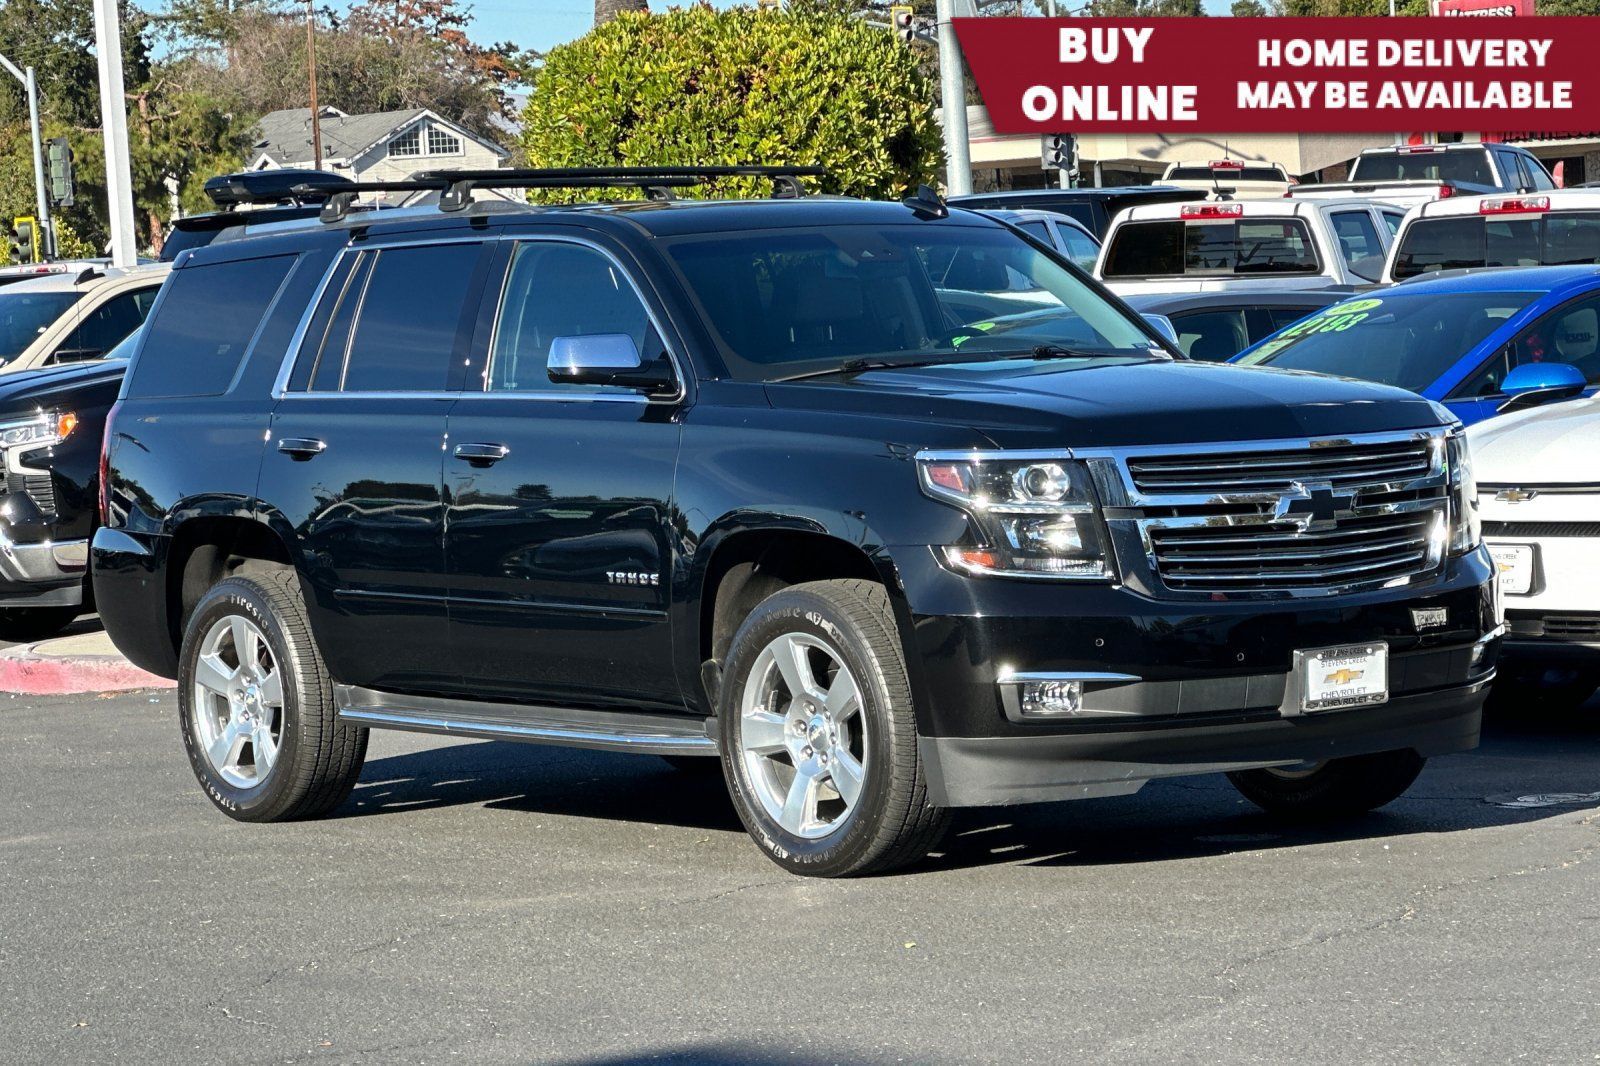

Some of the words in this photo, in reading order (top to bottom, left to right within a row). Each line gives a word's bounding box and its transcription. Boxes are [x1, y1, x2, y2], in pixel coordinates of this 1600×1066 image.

[605, 571, 660, 586] TAHOE
[1321, 649, 1348, 658] STEVENS
[1349, 647, 1367, 655] CREEK
[1321, 659, 1348, 668] STEVENS
[1349, 657, 1368, 665] CREEK
[1321, 686, 1367, 699] CHEVROLET
[1322, 696, 1367, 708] CHEVROLET
